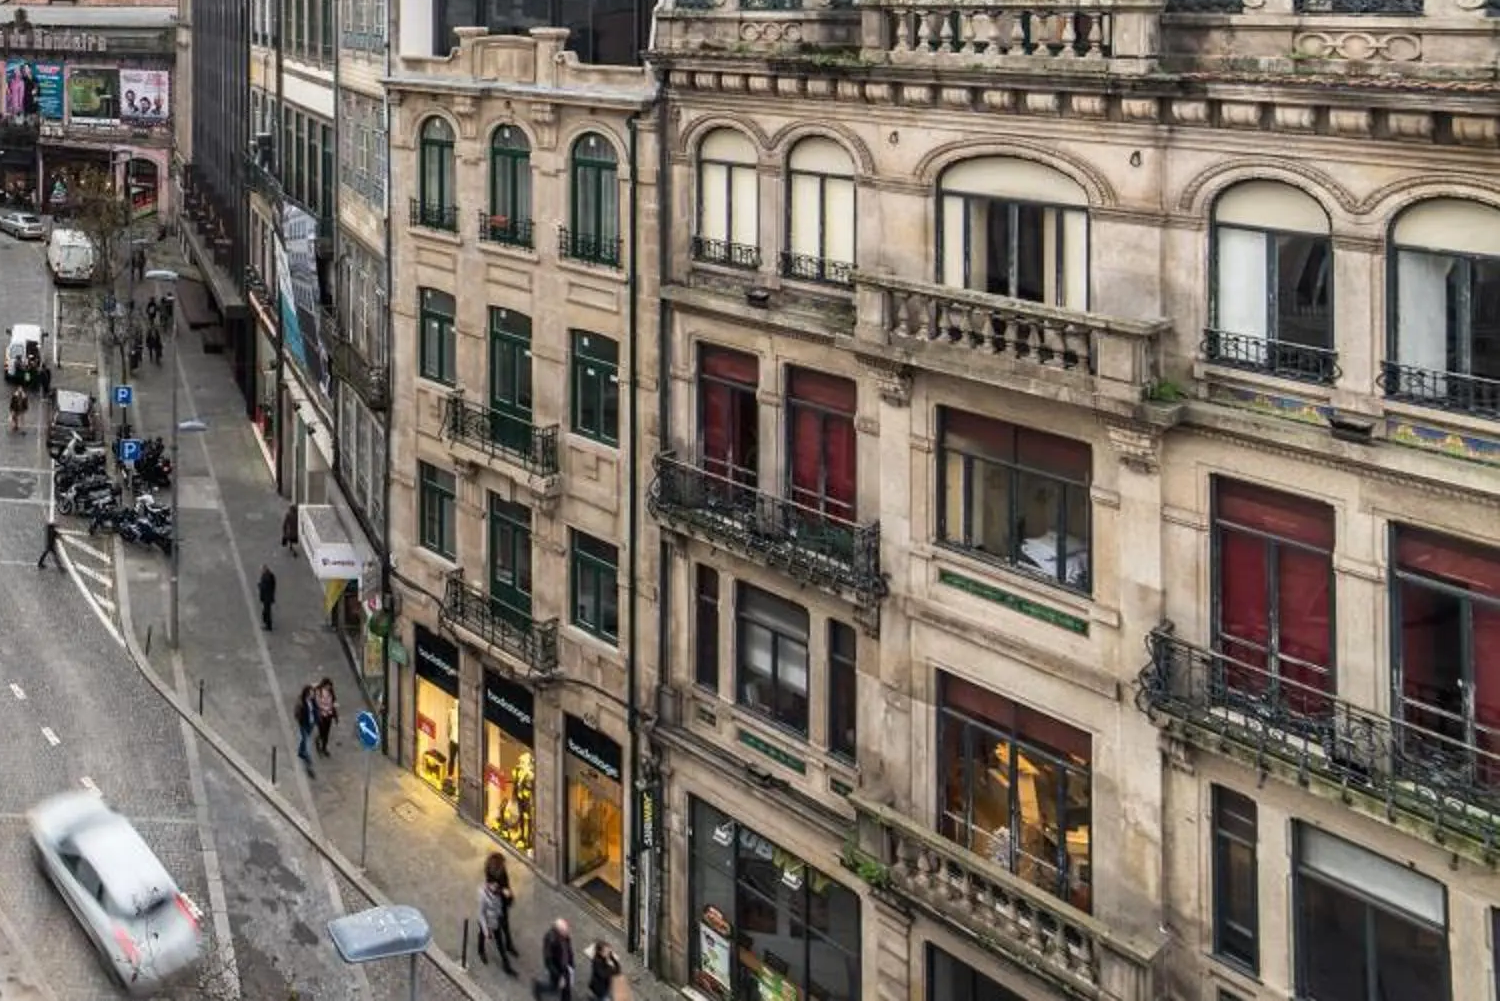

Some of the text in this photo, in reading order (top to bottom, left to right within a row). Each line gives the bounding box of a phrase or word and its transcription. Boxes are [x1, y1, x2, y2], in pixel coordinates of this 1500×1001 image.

[117, 389, 128, 401] P
[124, 443, 136, 458] P
[643, 791, 653, 847] SUBWAY
